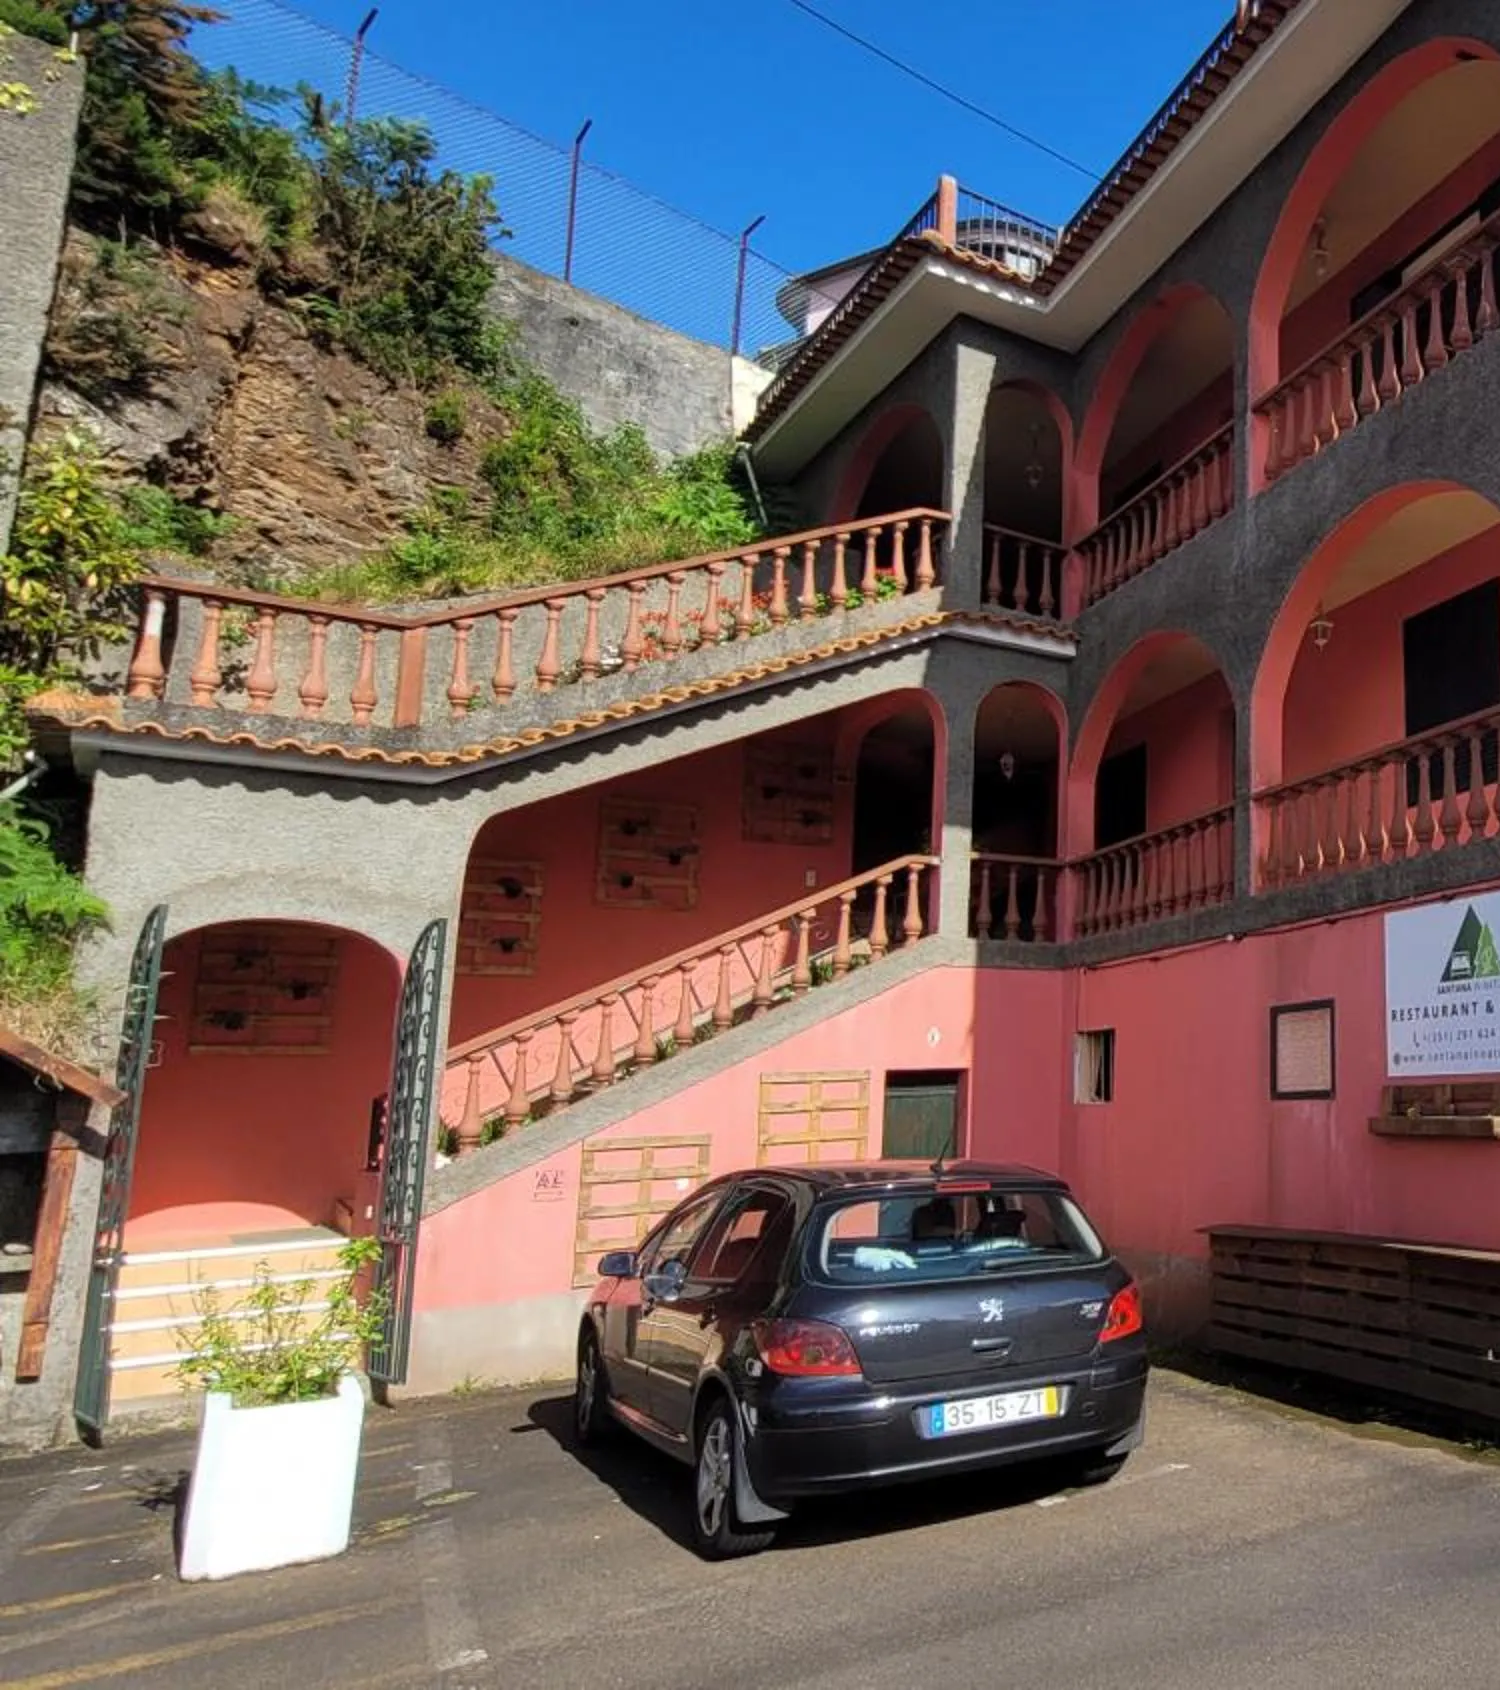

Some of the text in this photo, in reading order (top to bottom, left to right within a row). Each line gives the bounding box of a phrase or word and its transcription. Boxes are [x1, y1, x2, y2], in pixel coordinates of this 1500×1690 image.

[1437, 983, 1472, 994] SANTANA
[1391, 1001, 1479, 1022] RESTAURANT
[1485, 999, 1495, 1014] &
